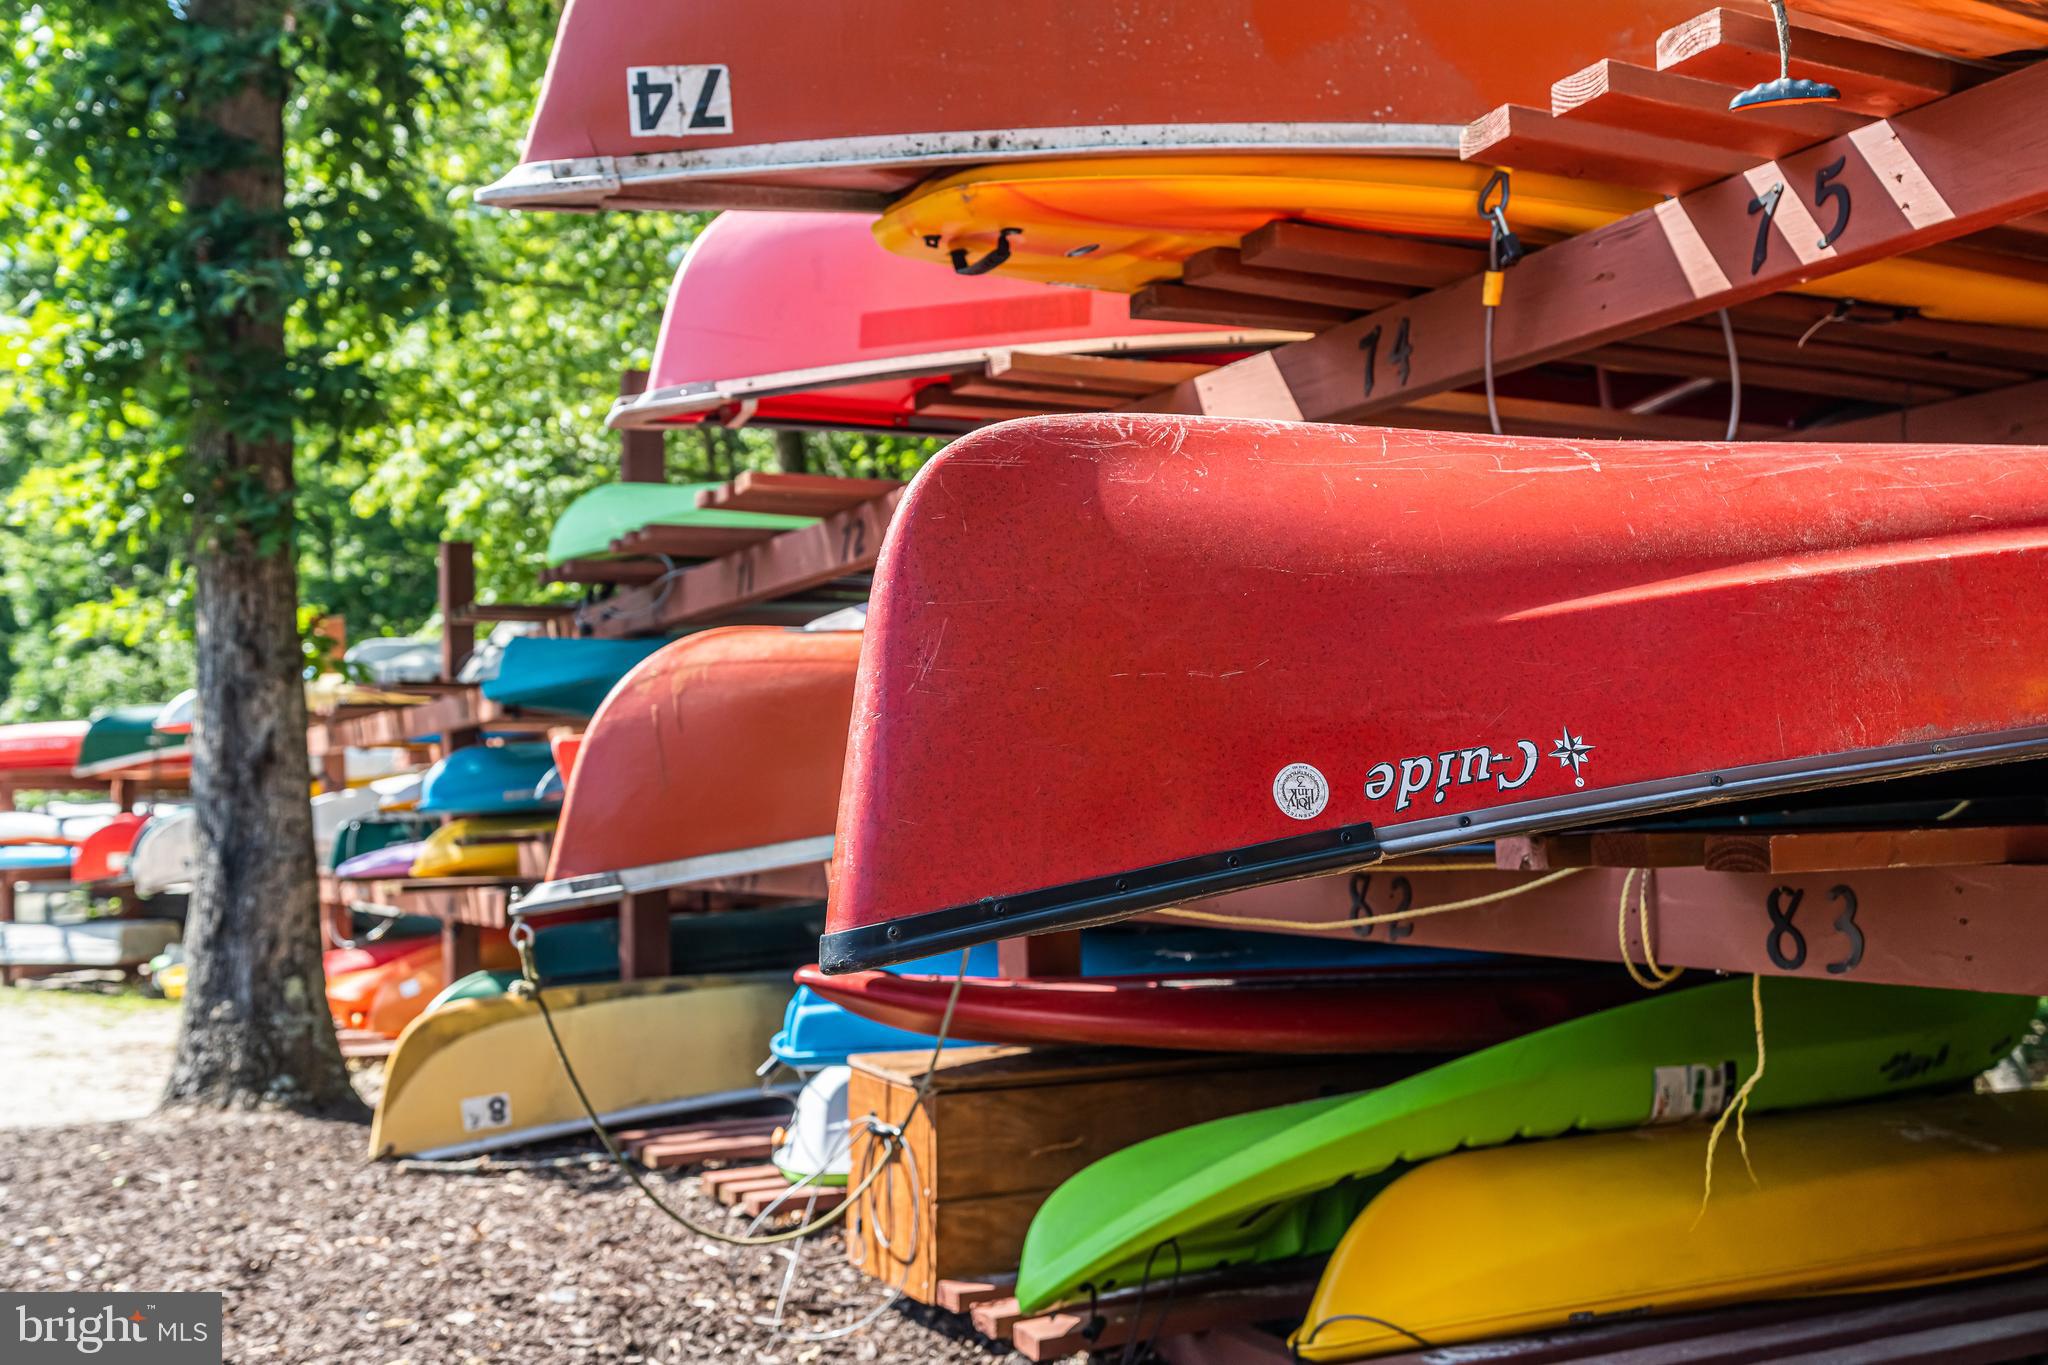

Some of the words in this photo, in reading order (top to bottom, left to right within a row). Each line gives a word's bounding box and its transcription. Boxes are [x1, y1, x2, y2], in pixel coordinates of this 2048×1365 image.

[632, 69, 725, 130] 74
[1747, 156, 1851, 275] 75
[1359, 316, 1413, 398] 74
[1287, 796, 1312, 810] Poly
[1289, 788, 1314, 804] Link
[1296, 775, 1306, 788] 3
[1364, 739, 1538, 813] Guide
[1349, 873, 1414, 941] 82
[1766, 884, 1864, 974] 83
